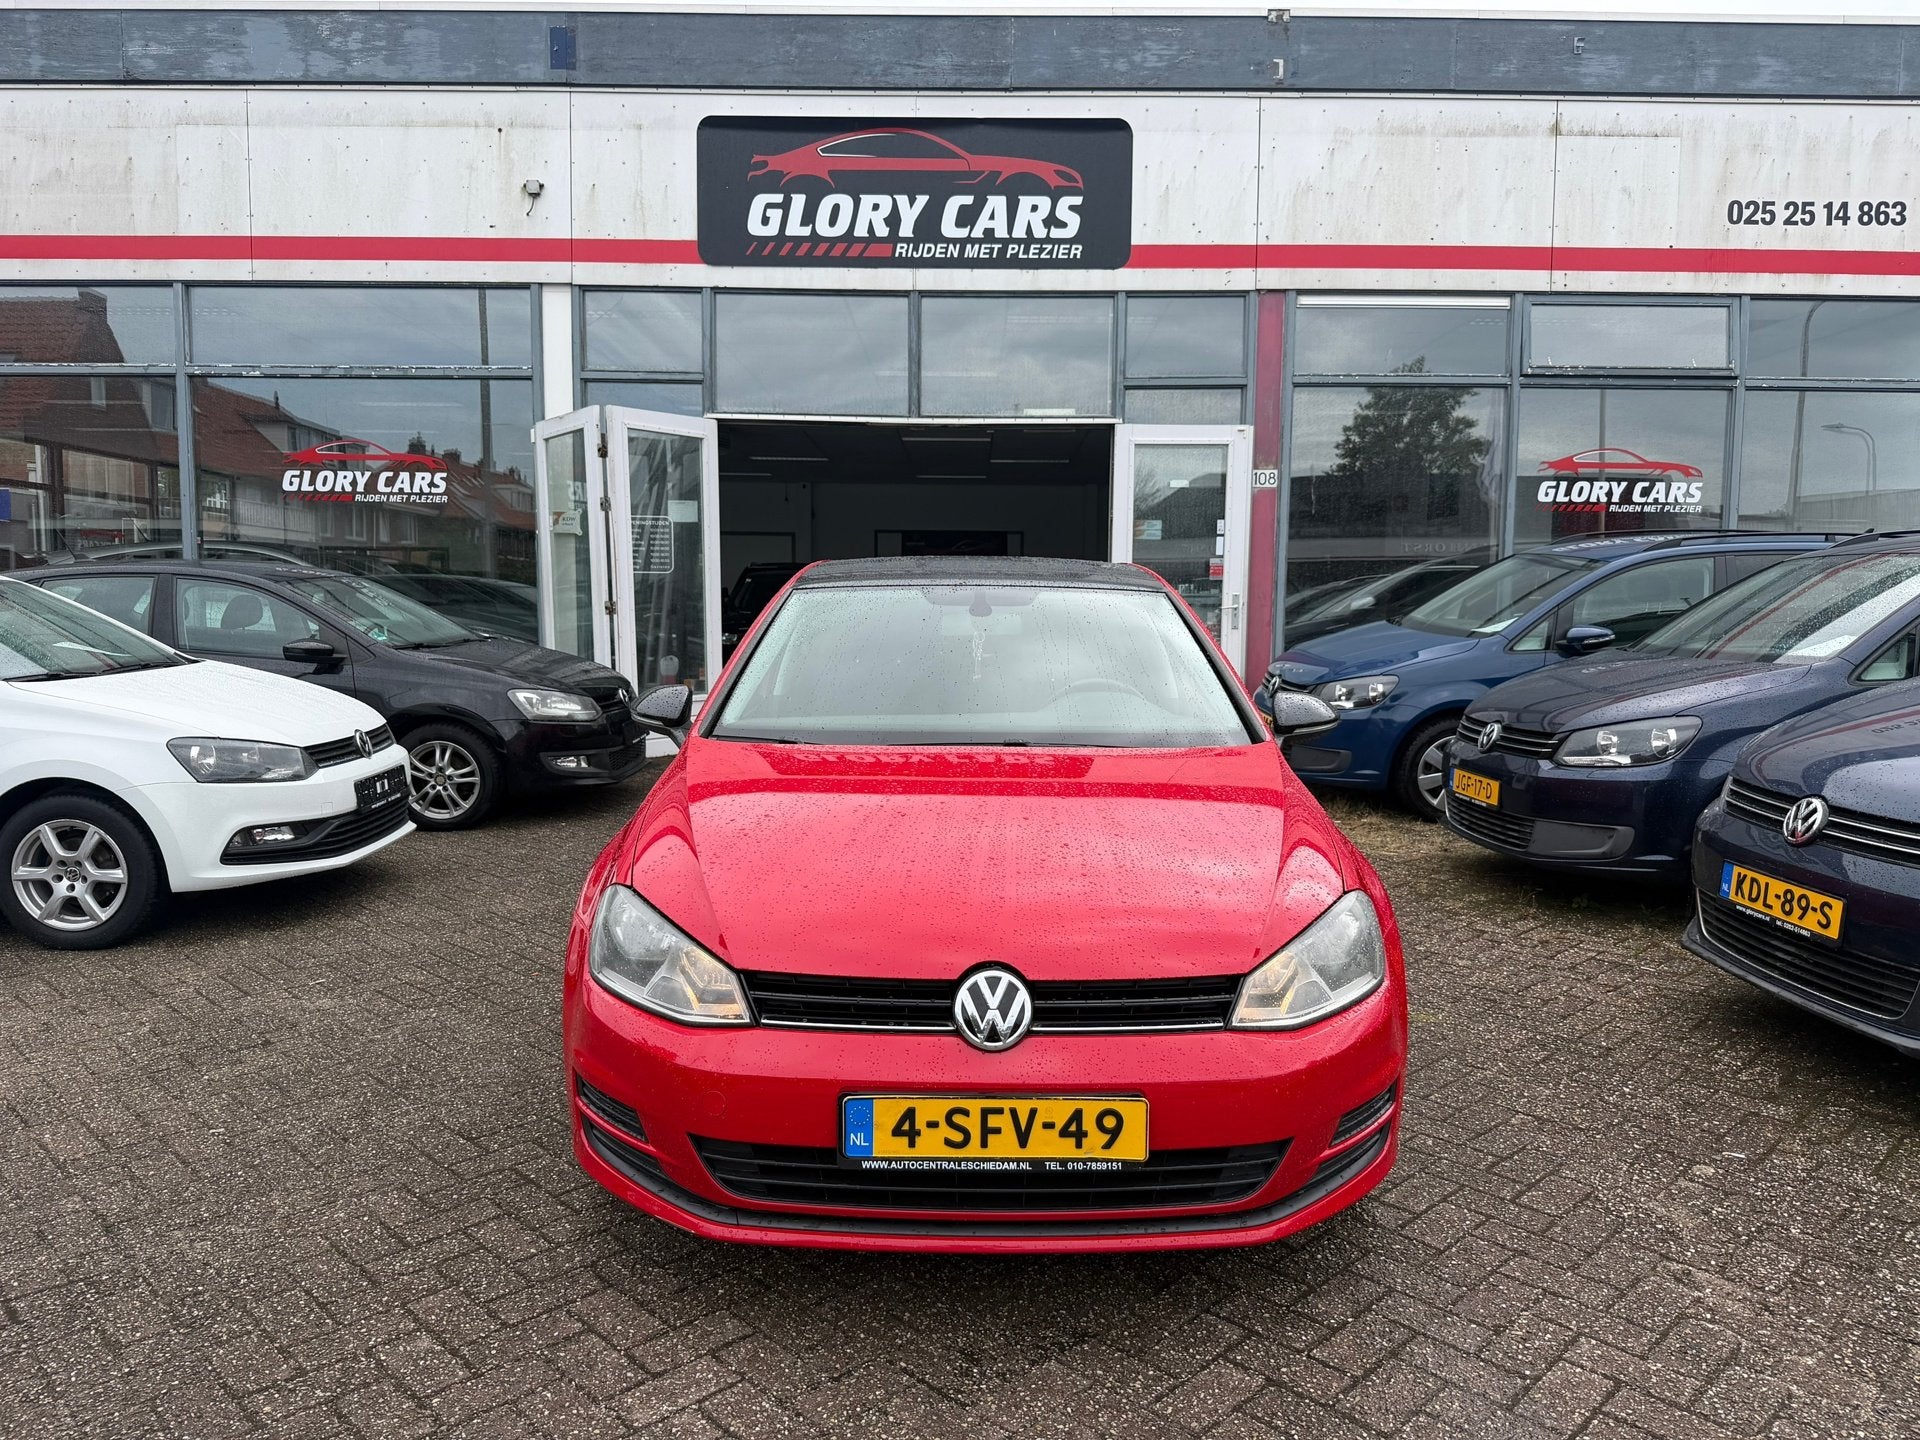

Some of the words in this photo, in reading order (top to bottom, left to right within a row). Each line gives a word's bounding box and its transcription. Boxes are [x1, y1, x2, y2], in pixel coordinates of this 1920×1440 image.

[746, 193, 930, 238] GLORY
[940, 195, 1084, 239] CARS
[1727, 199, 1776, 226] 025
[1783, 201, 1816, 226] 25
[1823, 201, 1851, 226] 14
[1857, 201, 1907, 227] 863
[894, 242, 961, 259] RIJDEN
[963, 243, 1002, 259] MET
[1005, 243, 1083, 260] PLEZIER
[282, 469, 372, 492] GLORY
[377, 471, 448, 494] CARS
[1253, 471, 1277, 486] 108
[354, 493, 389, 503] RIJDEN
[389, 494, 409, 503] MET
[410, 494, 448, 504] PLEZIER
[1537, 480, 1629, 503] GLORY
[1632, 481, 1703, 504] CARS
[1608, 504, 1643, 513] RIJDEN
[1643, 504, 1663, 513] MET
[1663, 504, 1703, 514] PLEZIER
[1455, 772, 1493, 800] JGF-17-D
[1734, 871, 1833, 930] KDL-89-S
[849, 1132, 869, 1146] NL
[891, 1106, 1125, 1150] 4-SFV-49
[861, 1160, 1033, 1171] WWW.AUTOCENTRALESCHIEDAM.NL
[1044, 1161, 1066, 1171] TEL.
[1067, 1161, 1123, 1171] 010-7859151
